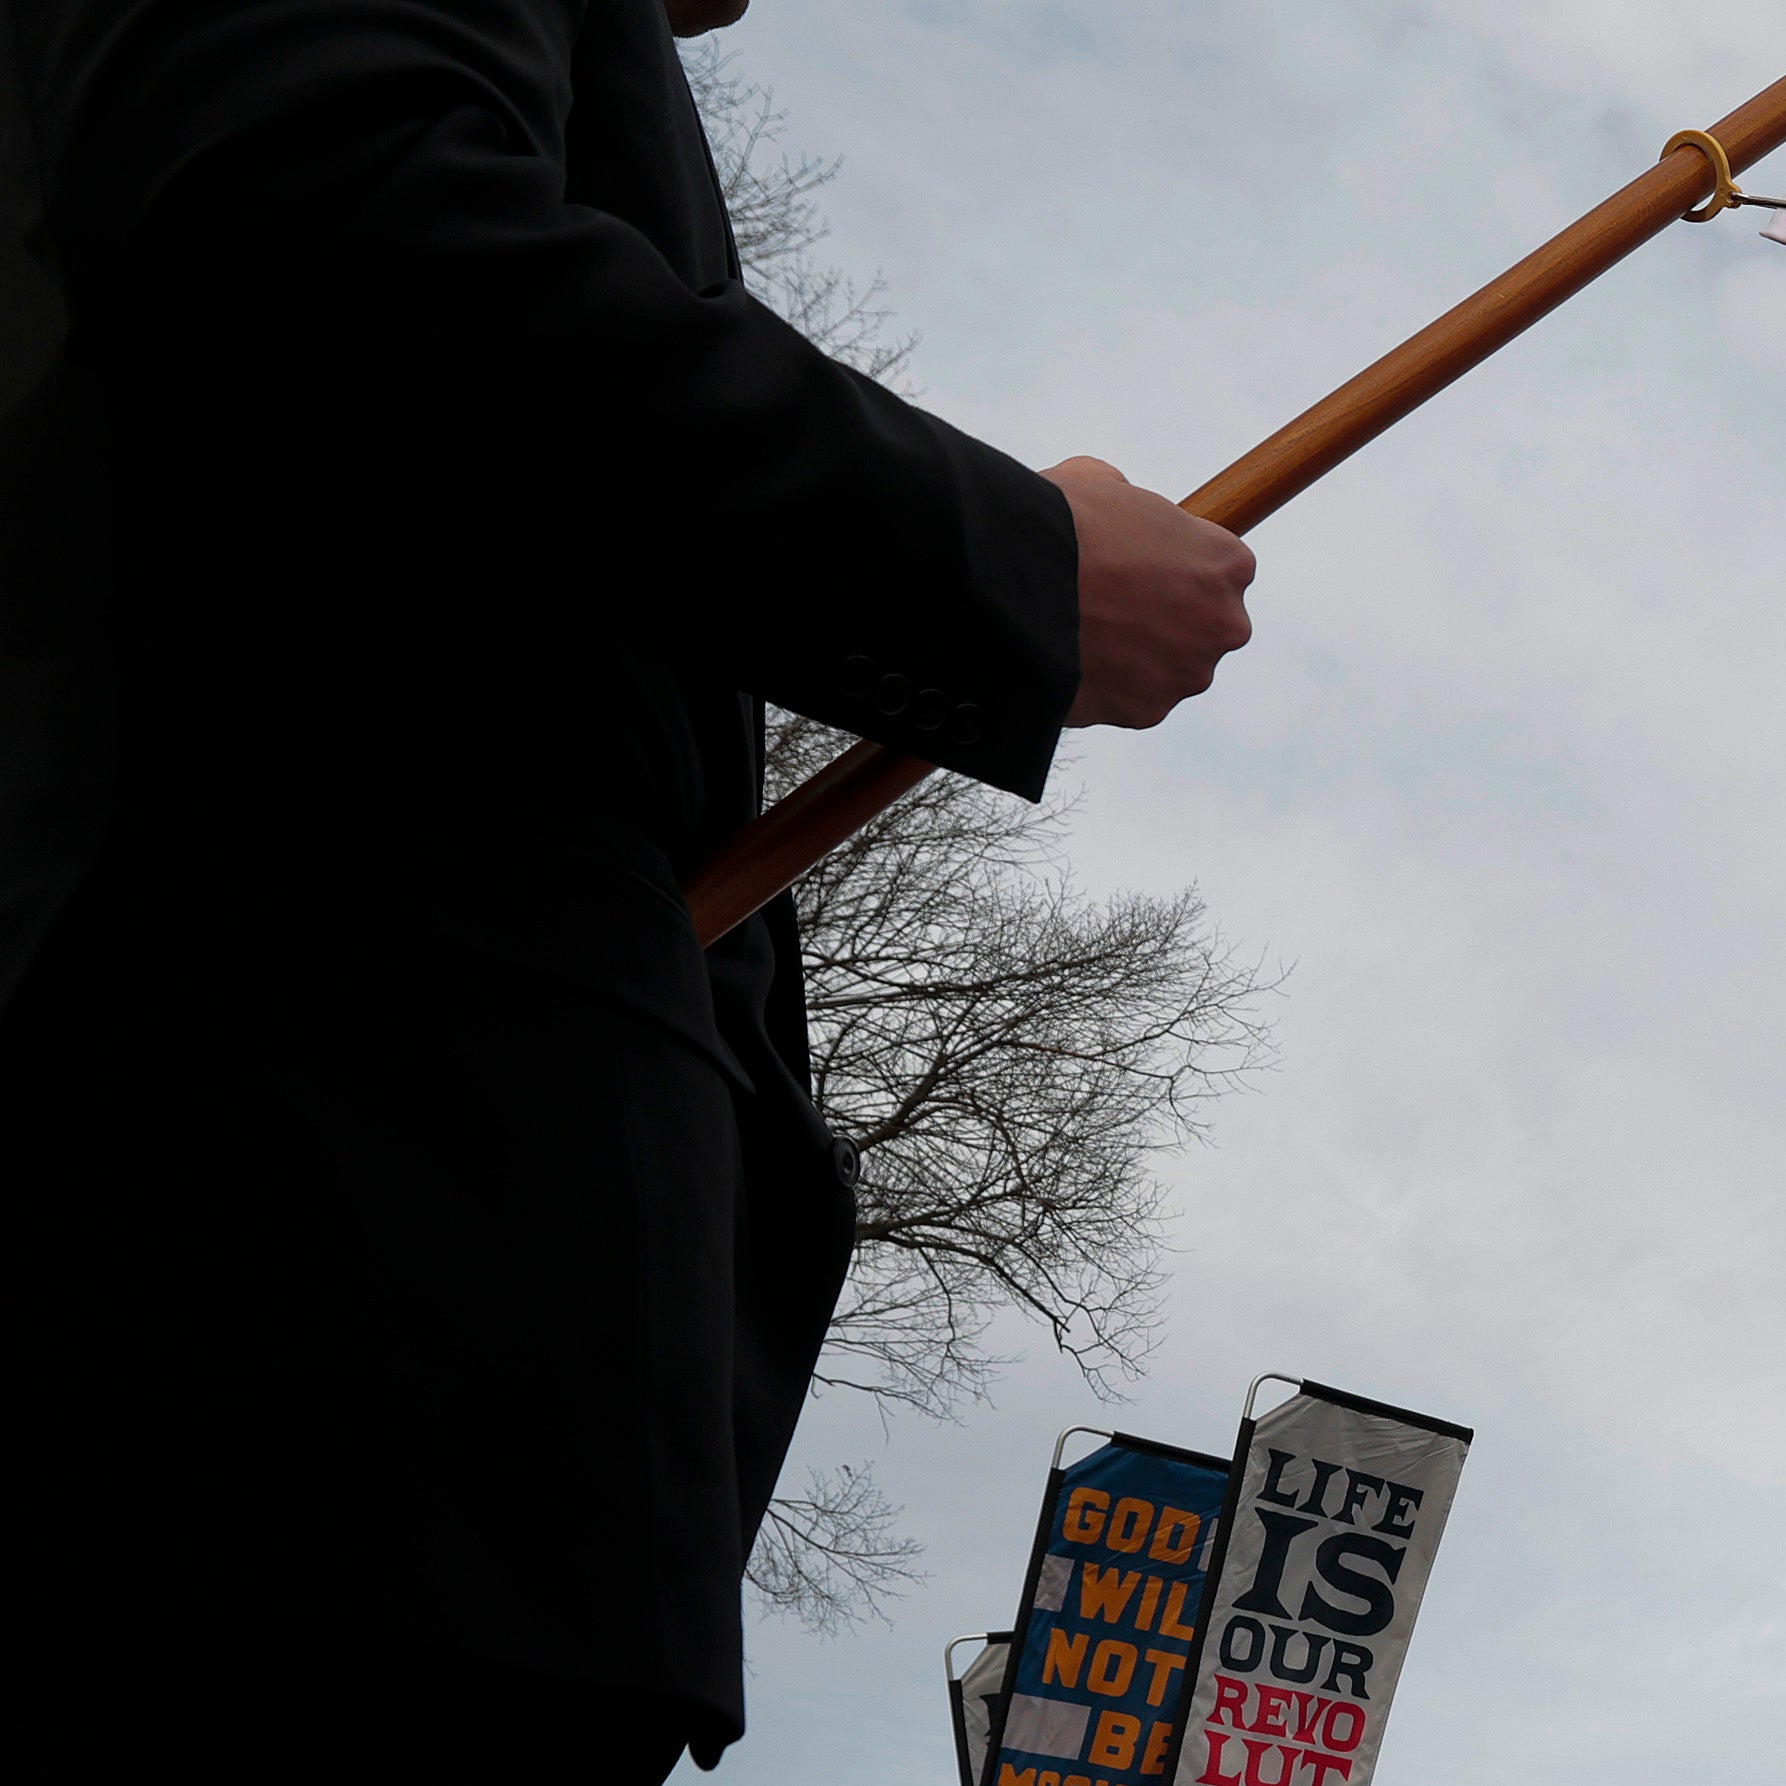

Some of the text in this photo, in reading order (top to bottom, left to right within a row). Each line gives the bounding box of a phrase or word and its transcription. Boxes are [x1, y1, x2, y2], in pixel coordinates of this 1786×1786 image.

[1062, 1486, 1201, 1565] GOD
[1256, 1447, 1425, 1540] LIFE
[1079, 1561, 1197, 1641] WIL
[1231, 1506, 1407, 1637] IS
[1042, 1627, 1187, 1708] NOT
[1219, 1614, 1374, 1701] OUR
[1088, 1709, 1174, 1775] BE
[1206, 1673, 1366, 1753] REVO
